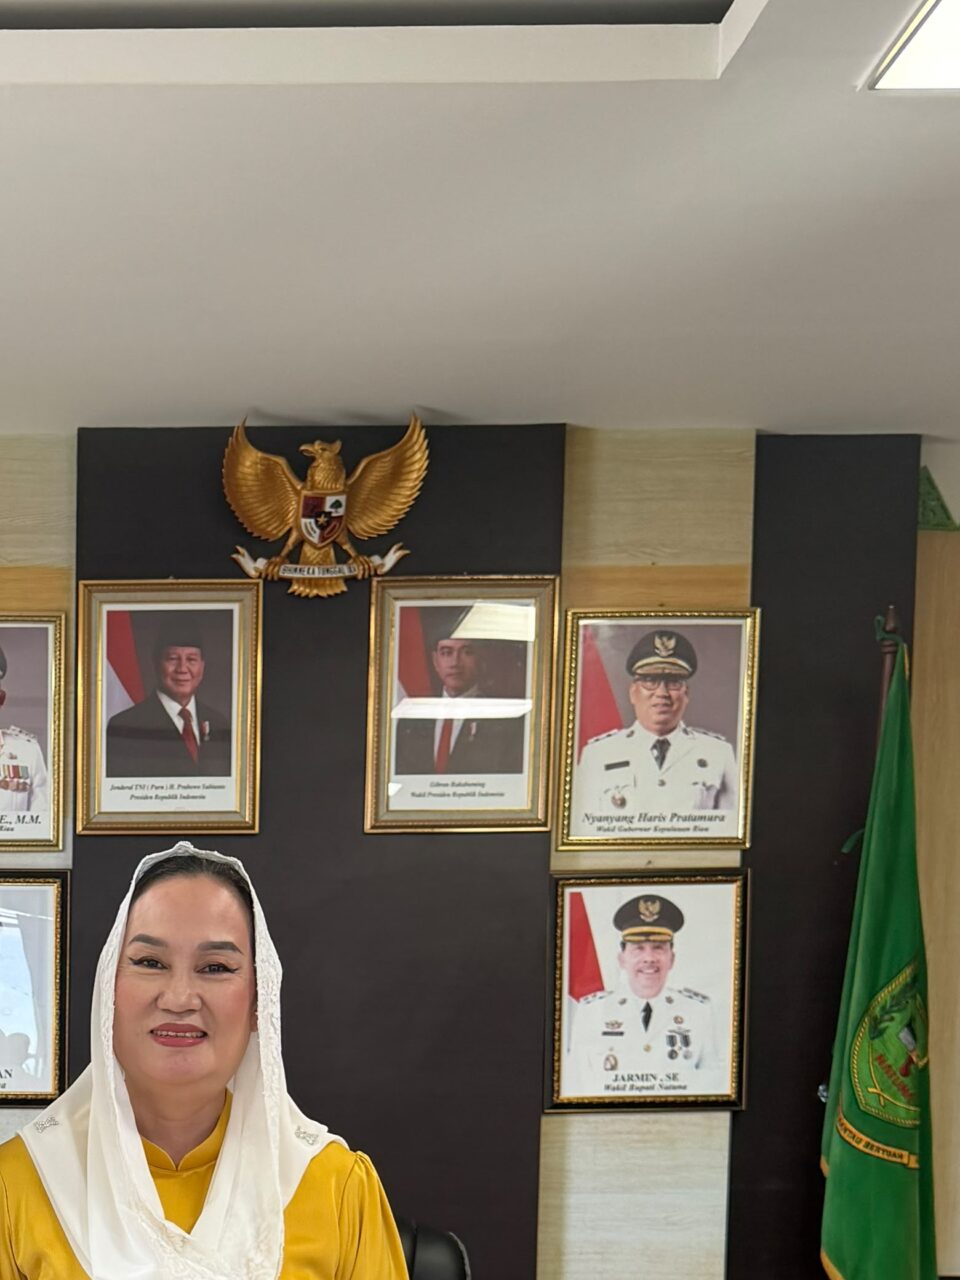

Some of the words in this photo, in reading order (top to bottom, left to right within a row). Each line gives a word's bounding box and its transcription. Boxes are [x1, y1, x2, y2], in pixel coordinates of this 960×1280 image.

[15, 815, 41, 824] M.M.
[582, 812, 634, 825] Nyanyang
[637, 812, 666, 822] Haris
[665, 1072, 679, 1081] SE
